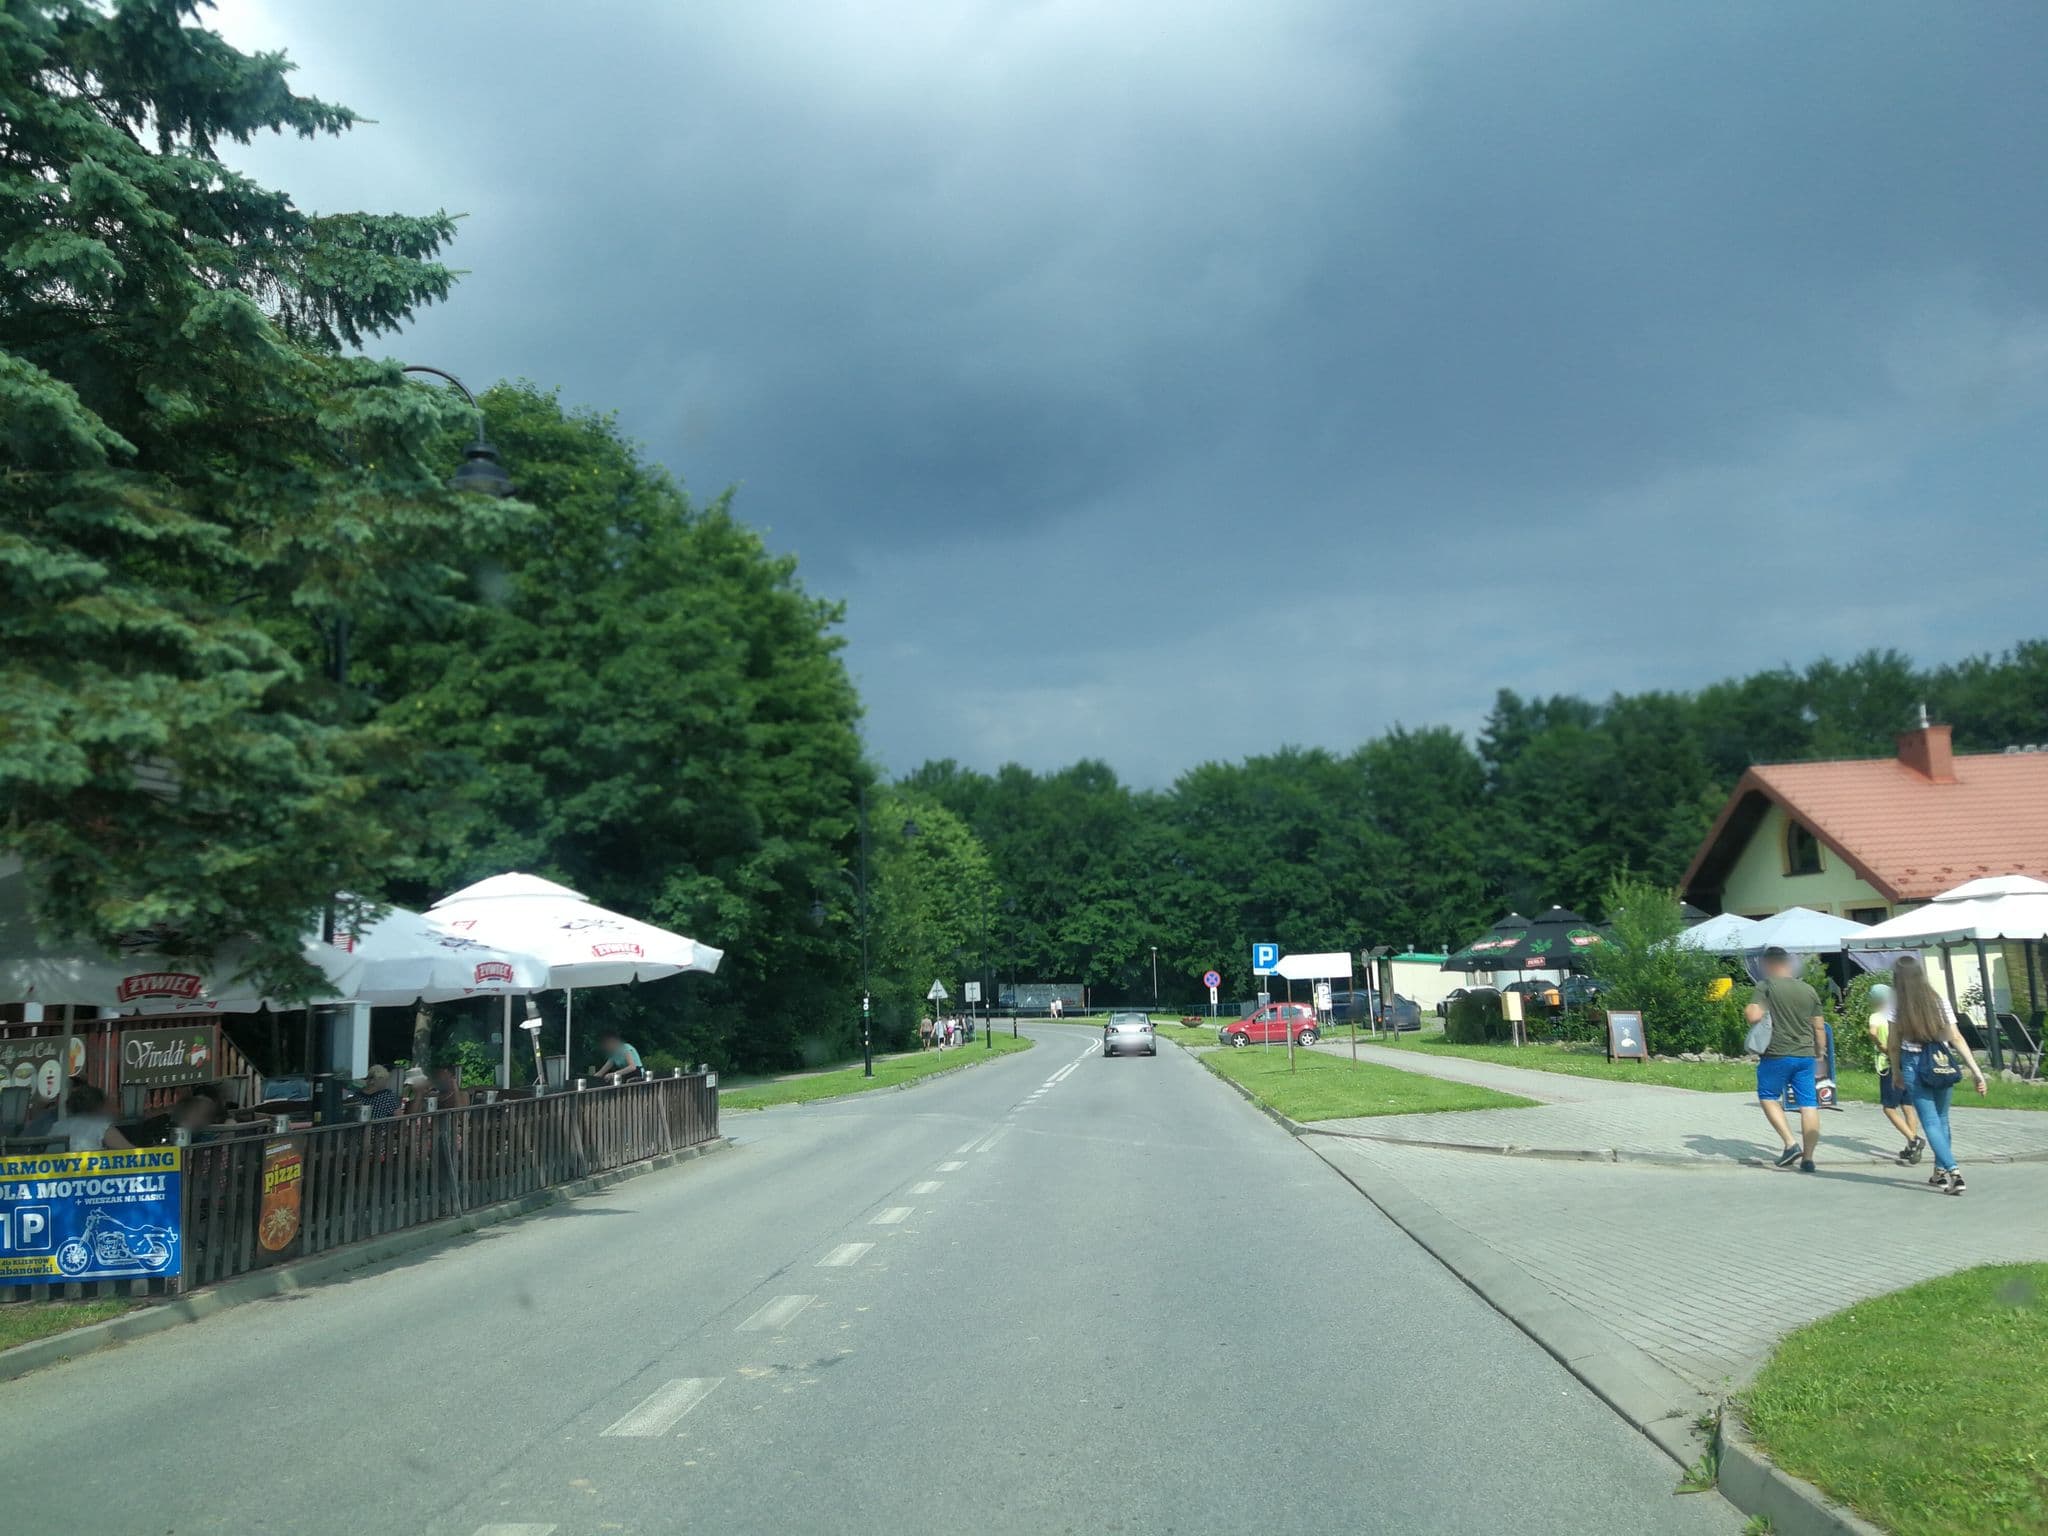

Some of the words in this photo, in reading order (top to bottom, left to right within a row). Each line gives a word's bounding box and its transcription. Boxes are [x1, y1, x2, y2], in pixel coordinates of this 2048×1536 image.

[1258, 946, 1274, 967] P
[125, 1040, 187, 1069] Vivaldi
[87, 1152, 174, 1171] PARKING
[37, 1175, 166, 1199] MOTOCYKLI
[264, 1163, 301, 1194] pizza
[85, 1195, 123, 1205] WIESZAK
[124, 1195, 137, 1203] NA
[138, 1193, 166, 1202] KASKI
[23, 1213, 45, 1243] P
